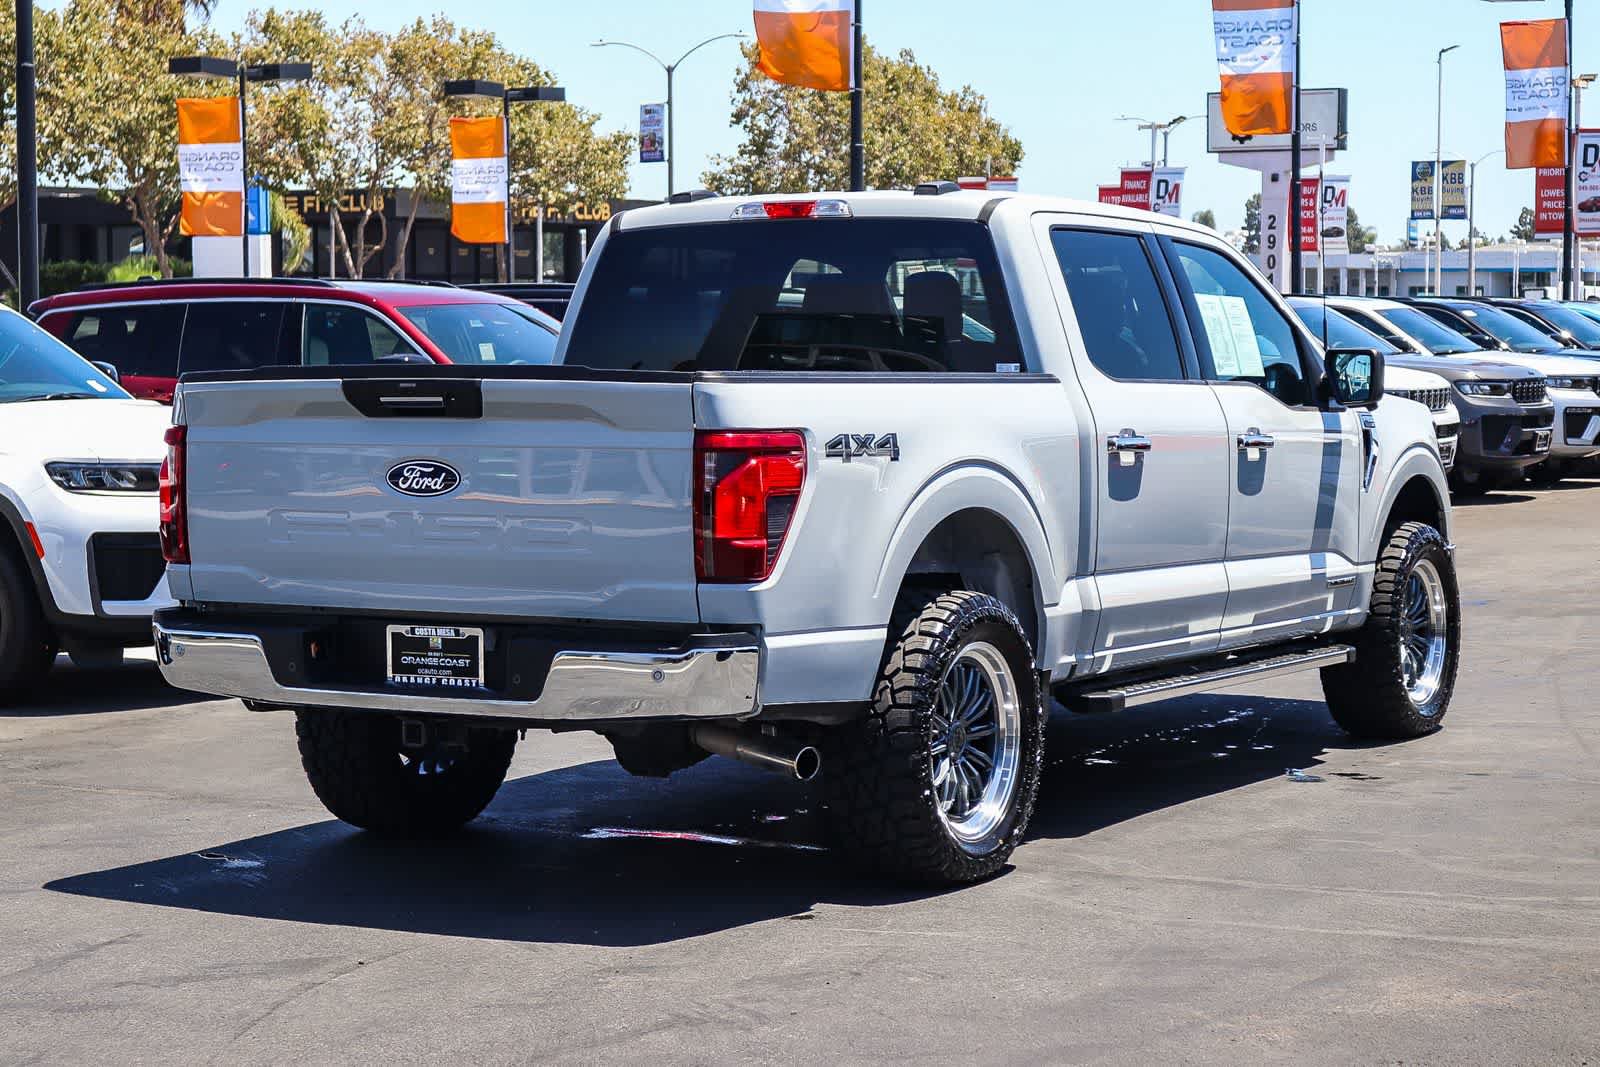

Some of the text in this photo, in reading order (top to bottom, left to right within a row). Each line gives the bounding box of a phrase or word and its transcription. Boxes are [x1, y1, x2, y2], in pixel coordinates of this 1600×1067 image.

[1539, 168, 1565, 177] PRIORIT
[1442, 172, 1464, 185] KBB
[1124, 180, 1147, 190] FINANCE
[1303, 186, 1316, 195] BUY
[1541, 188, 1565, 198] LOWES
[1121, 193, 1149, 203] AVAILABLE
[338, 194, 384, 213] CLUB
[575, 202, 611, 220] CLUB
[1548, 212, 1565, 221] TOW
[399, 465, 446, 490] Ford
[414, 627, 456, 637] COSTA MESA
[401, 656, 471, 667] ORANGE COAST
